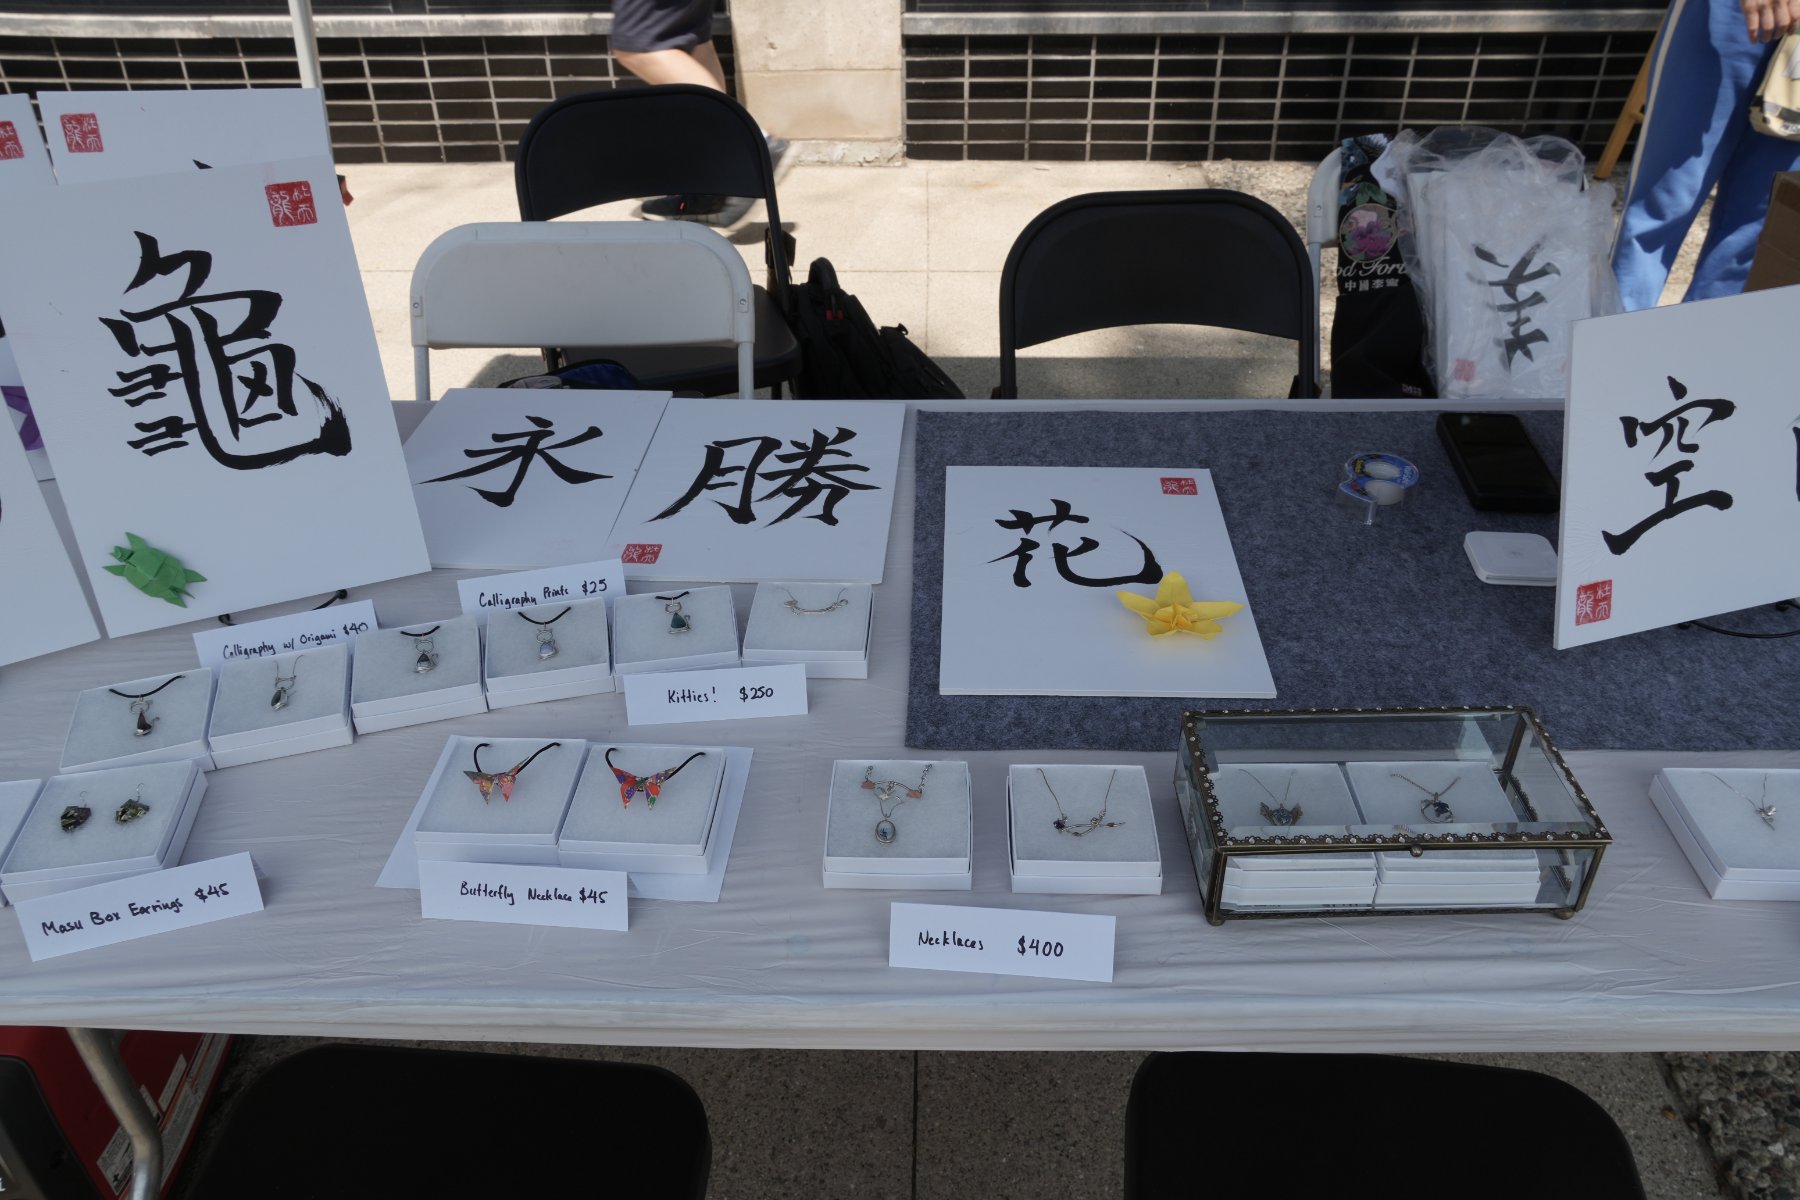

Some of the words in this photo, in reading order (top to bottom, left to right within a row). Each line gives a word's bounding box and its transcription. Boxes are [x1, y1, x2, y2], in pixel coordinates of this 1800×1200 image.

[416, 415, 614, 507] 永
[642, 426, 882, 528] 勝
[1602, 375, 1736, 556] 空
[986, 498, 1164, 588] 花
[479, 591, 537, 609] Calligraphy
[543, 585, 569, 600] Prints
[581, 578, 608, 596] $25
[222, 641, 276, 659] Calligraphy
[282, 638, 295, 650] w/
[299, 629, 337, 645] Origami
[342, 622, 369, 636] $40
[667, 686, 717, 704] Kitties!
[739, 685, 774, 703] $250
[41, 919, 85, 936] Masu
[89, 911, 121, 927] Box
[128, 897, 184, 917] Earrings
[194, 882, 230, 903] $45
[460, 880, 515, 906] Butterfly
[578, 886, 609, 904] $45
[918, 929, 984, 951] Necklaces
[1017, 935, 1064, 957] $400
